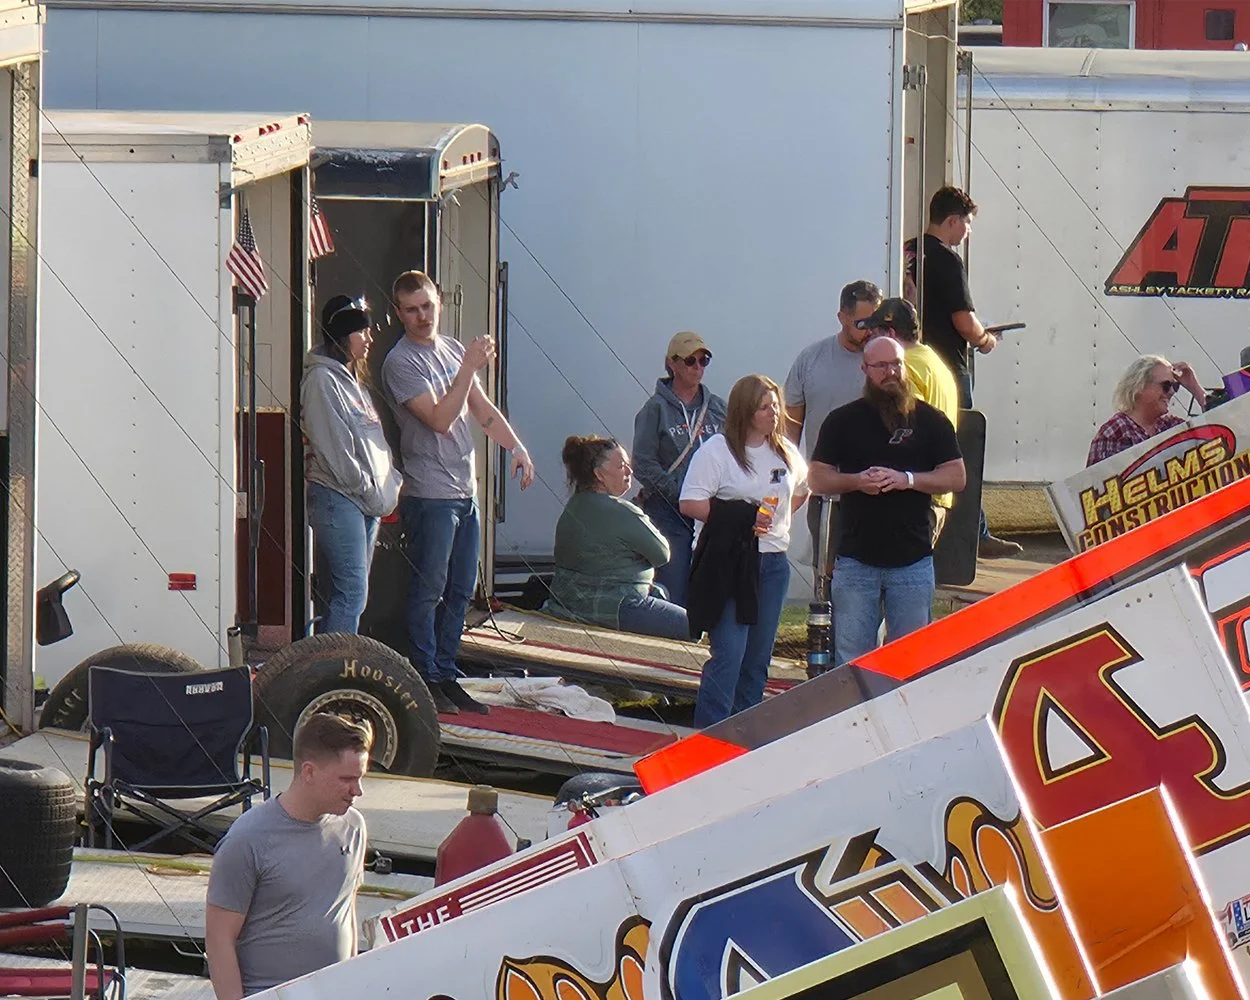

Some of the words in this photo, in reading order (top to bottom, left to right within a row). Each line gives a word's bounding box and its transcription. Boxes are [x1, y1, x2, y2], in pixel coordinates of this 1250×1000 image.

[1108, 285, 1165, 295] ASHLEY
[1167, 285, 1232, 296] TACKETT
[1080, 436, 1229, 527] HELMS
[340, 657, 418, 711] Hoosier
[400, 905, 449, 935] THE
